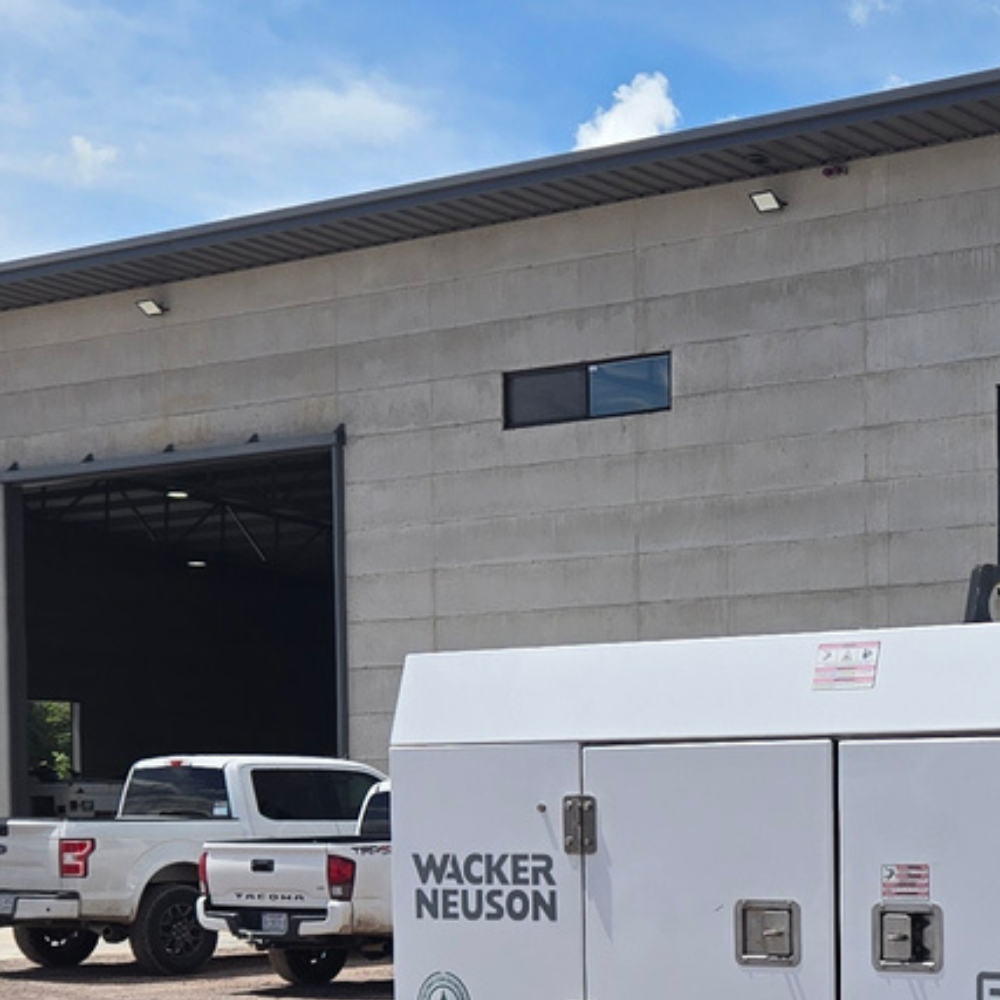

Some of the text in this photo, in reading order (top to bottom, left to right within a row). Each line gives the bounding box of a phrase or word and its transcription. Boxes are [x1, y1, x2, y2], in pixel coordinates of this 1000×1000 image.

[412, 853, 556, 885] WACKER
[235, 892, 305, 901] TACOMA
[415, 888, 558, 921] NEUSON
